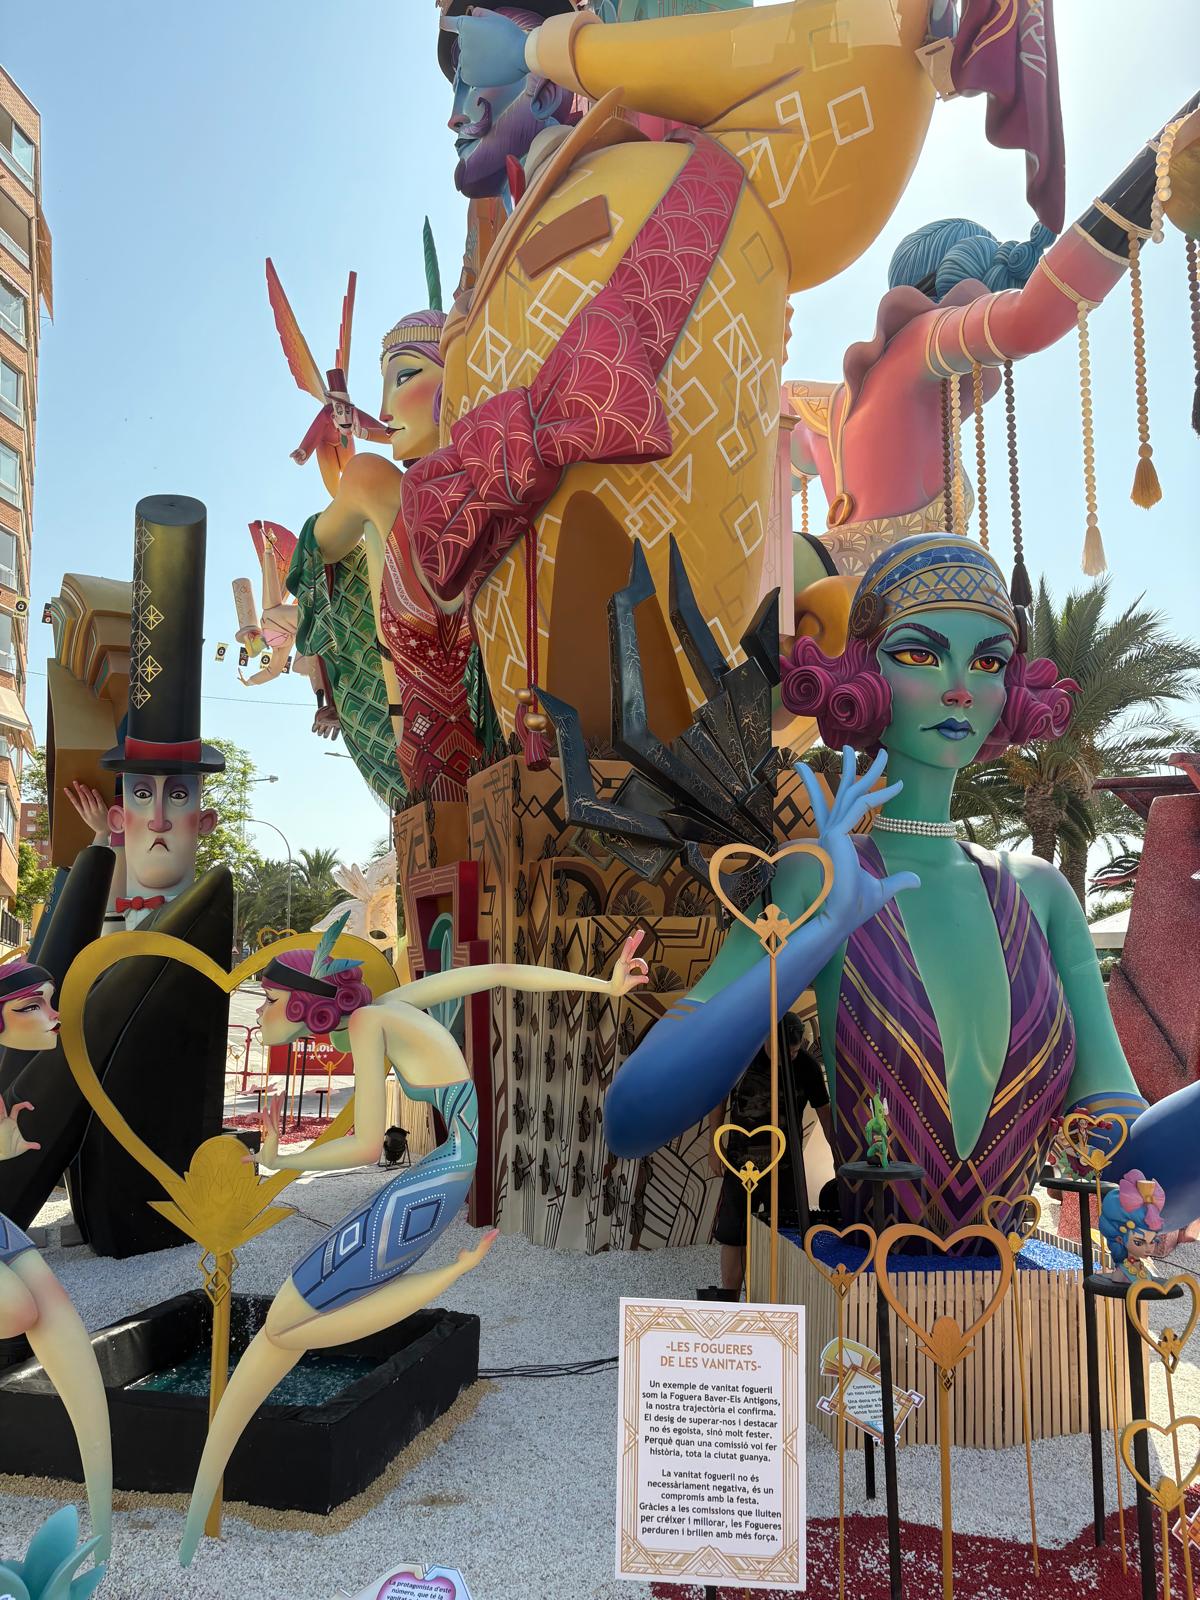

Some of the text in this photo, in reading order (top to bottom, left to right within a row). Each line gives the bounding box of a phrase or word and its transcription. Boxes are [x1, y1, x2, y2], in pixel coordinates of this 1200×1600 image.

[666, 1342, 753, 1356] -LES FOGUERES
[660, 1356, 761, 1371] DE LES VANITATS-
[662, 1382, 697, 1391] exemple
[711, 1384, 739, 1392] vanitat
[741, 1384, 773, 1395] fogueril
[670, 1392, 702, 1402] Foguera
[704, 1394, 741, 1404] Baver-Els
[743, 1396, 780, 1406] Antigons,
[646, 1401, 653, 1410] la
[682, 1404, 725, 1414] trajectòria
[738, 1407, 776, 1416] confirma.
[654, 1414, 674, 1424] desig
[676, 1415, 687, 1423] de
[689, 1418, 736, 1426] superar-nos
[743, 1419, 778, 1428] destacar
[662, 1425, 670, 1433] és
[672, 1427, 704, 1436] egoista,
[706, 1428, 723, 1436] sinó
[725, 1429, 743, 1438] molt
[746, 1430, 772, 1439] fester.
[644, 1435, 673, 1446] Perquè
[675, 1439, 695, 1447] quan
[714, 1441, 748, 1449] comissió
[765, 1443, 777, 1451] fer
[650, 1447, 683, 1458] història,
[704, 1450, 711, 1458] la
[714, 1451, 737, 1460] ciutat
[740, 1454, 770, 1463] guanya.
[662, 1469, 671, 1477] La
[673, 1470, 702, 1479] vanitat
[704, 1472, 735, 1482] fogueril
[750, 1474, 759, 1482] és
[647, 1481, 710, 1491] necessàriament
[712, 1484, 749, 1494] negativa,
[752, 1485, 761, 1494] és
[661, 1493, 759, 1505] compromís amb la festa.
[639, 1502, 669, 1512] Gràcies
[678, 1504, 690, 1513] les
[692, 1506, 735, 1516] comissions
[737, 1510, 753, 1518] que
[755, 1509, 782, 1519] lluiten
[640, 1515, 782, 1531] per créixer i millorar, les Fogueres
[642, 1526, 679, 1535] perduren
[687, 1528, 713, 1537] brillen
[716, 1530, 733, 1539] amb
[735, 1531, 752, 1540] més
[754, 1532, 778, 1543] força.
[392, 1588, 415, 1596] número,
[397, 1582, 433, 1591] protagonista
